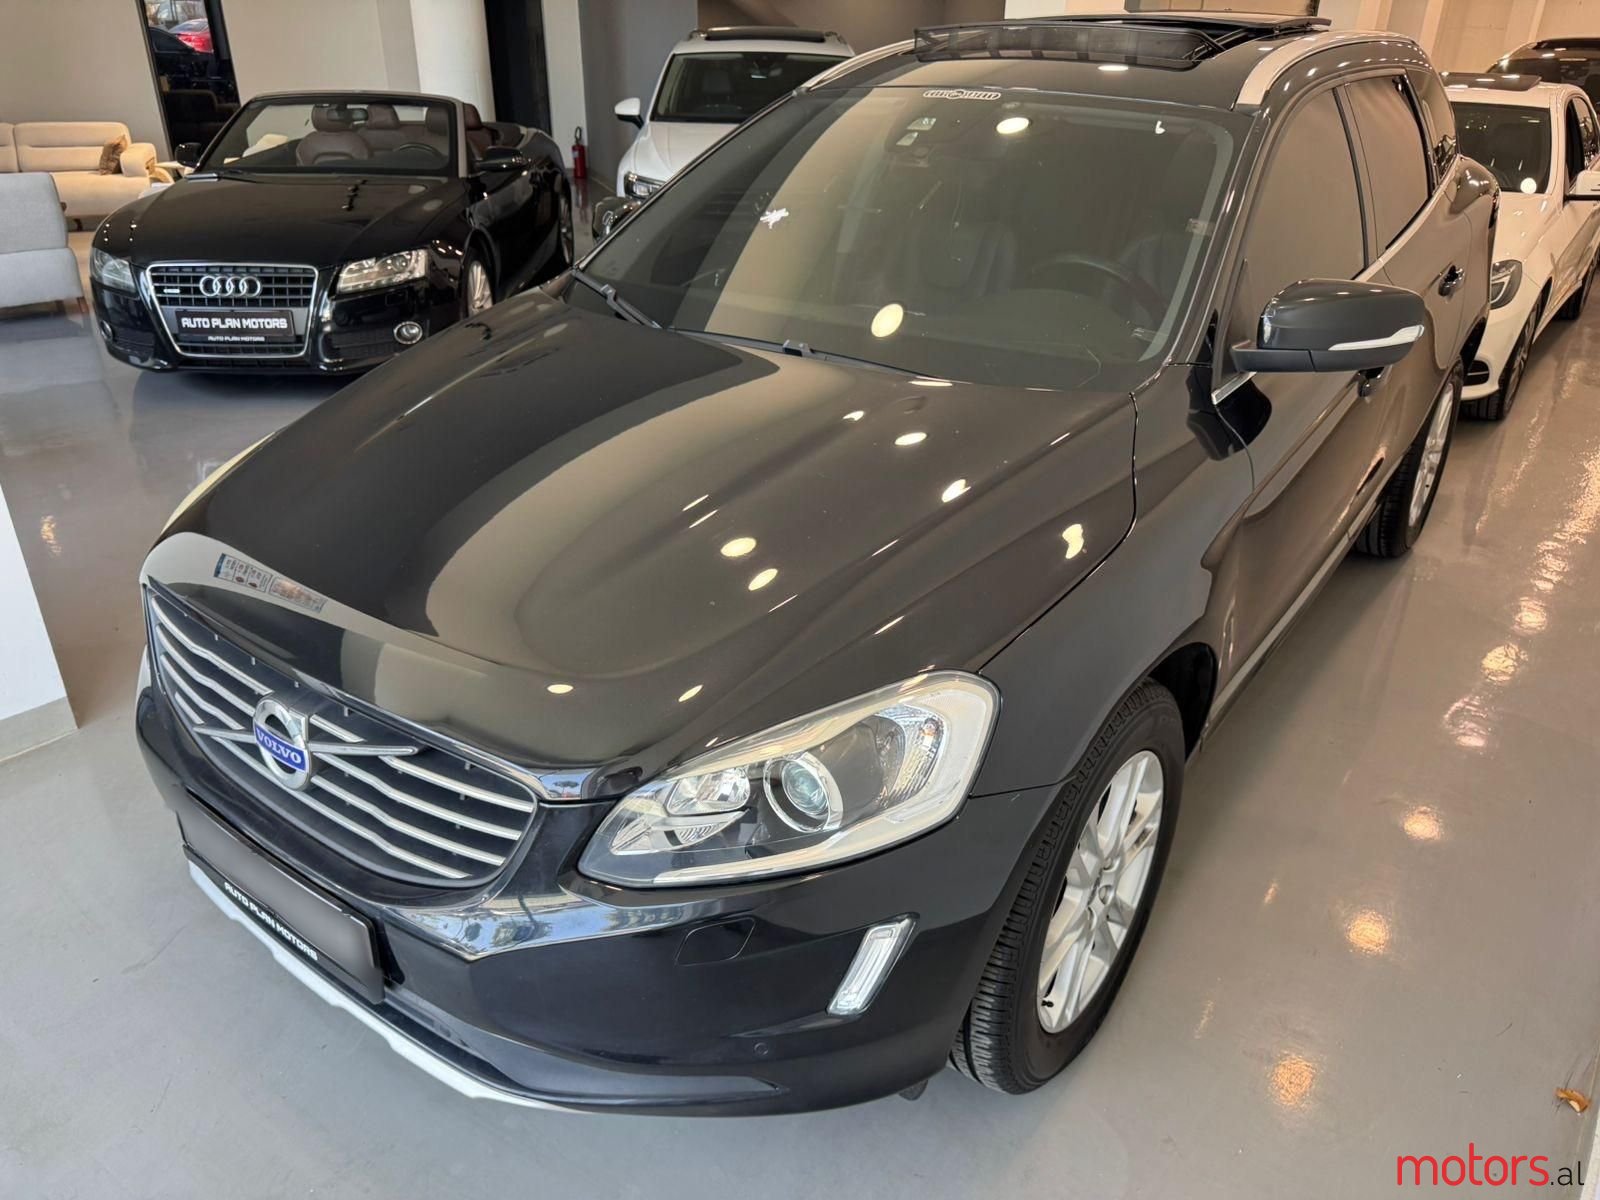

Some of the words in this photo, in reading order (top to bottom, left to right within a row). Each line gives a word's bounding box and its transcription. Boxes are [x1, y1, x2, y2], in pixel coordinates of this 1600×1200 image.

[181, 317, 210, 329] AUTO
[211, 317, 241, 329] PLAN
[242, 318, 288, 329] MOTORS
[256, 727, 302, 764] VOLVO
[224, 882, 249, 907] AUTO
[249, 902, 276, 929] PLAN
[275, 922, 318, 961] MOTORS
